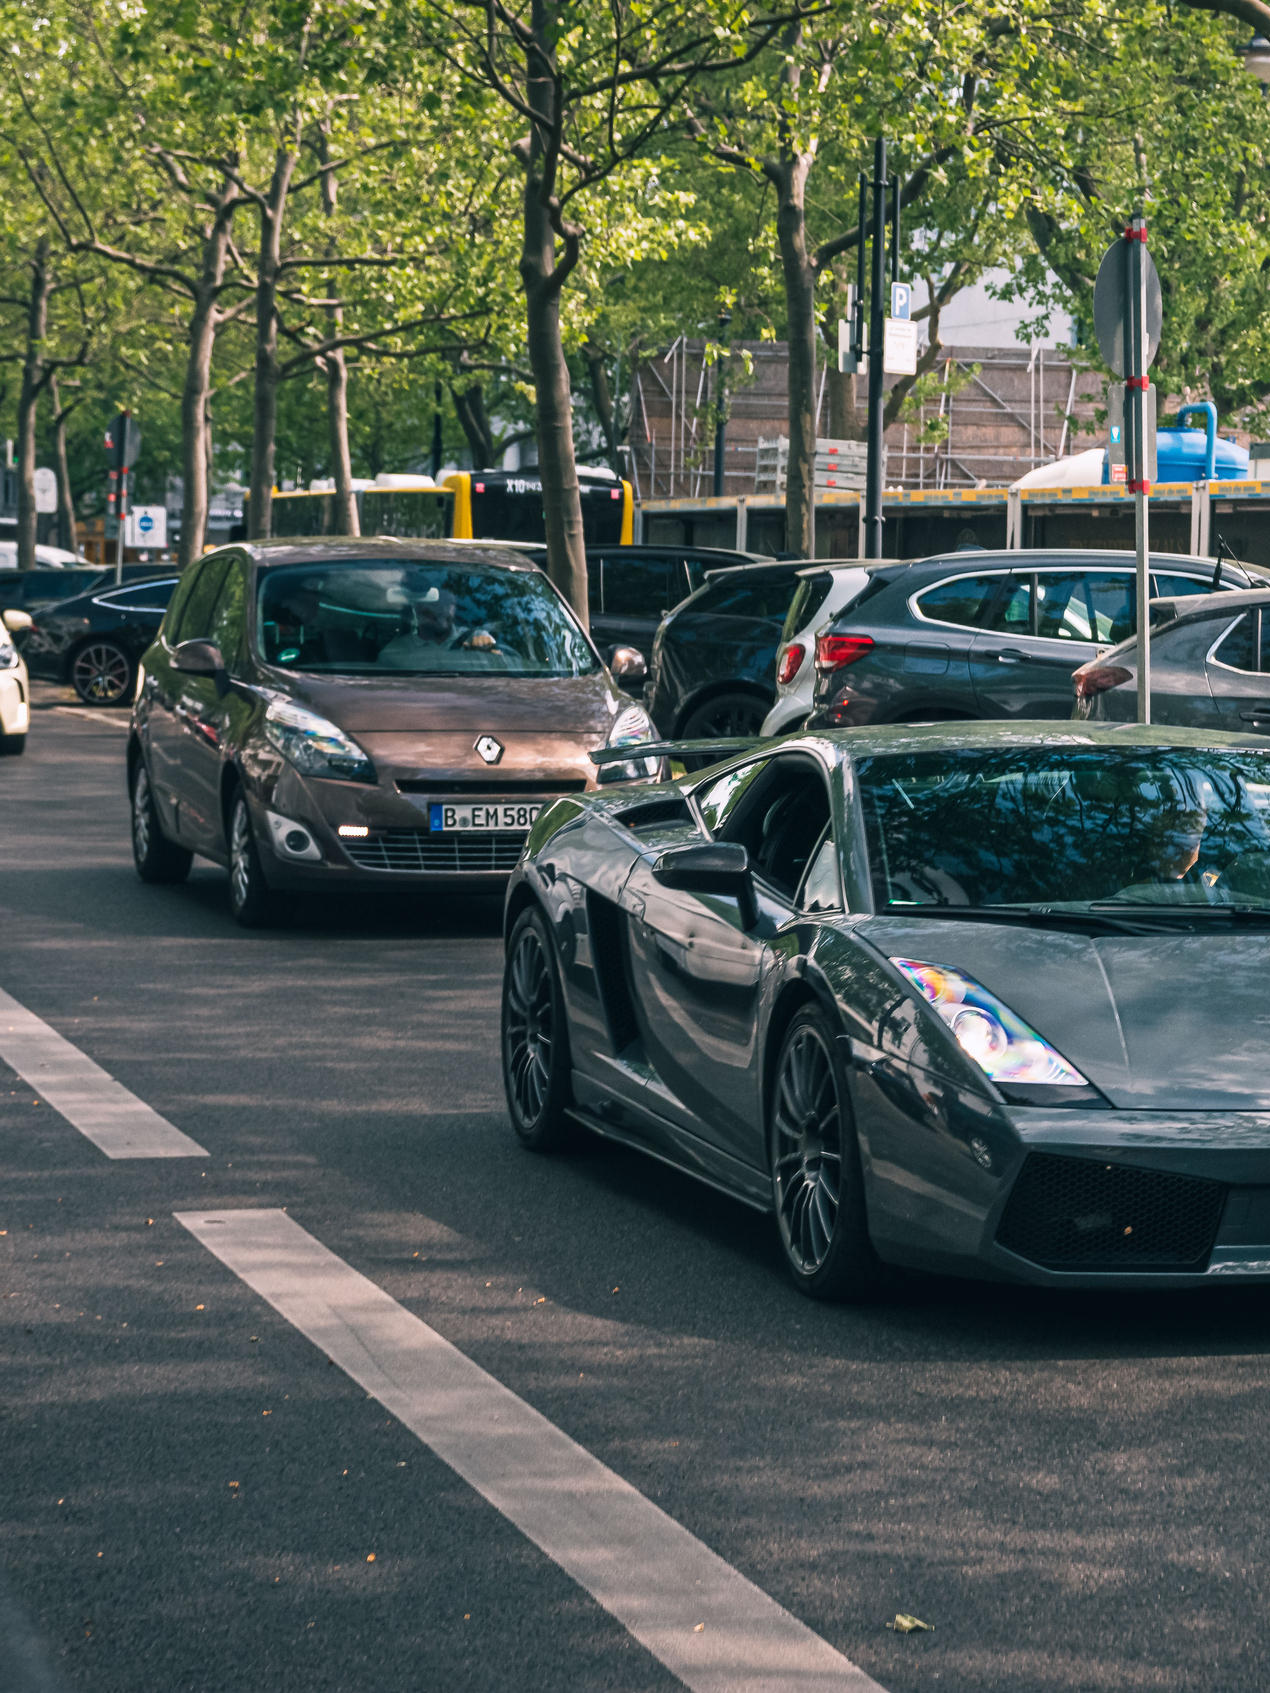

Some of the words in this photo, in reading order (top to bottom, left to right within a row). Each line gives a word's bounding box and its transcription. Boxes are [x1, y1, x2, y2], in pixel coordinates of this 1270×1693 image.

[895, 287, 908, 316] P
[506, 479, 526, 493] X10
[444, 807, 457, 828] B
[471, 807, 499, 827] EM
